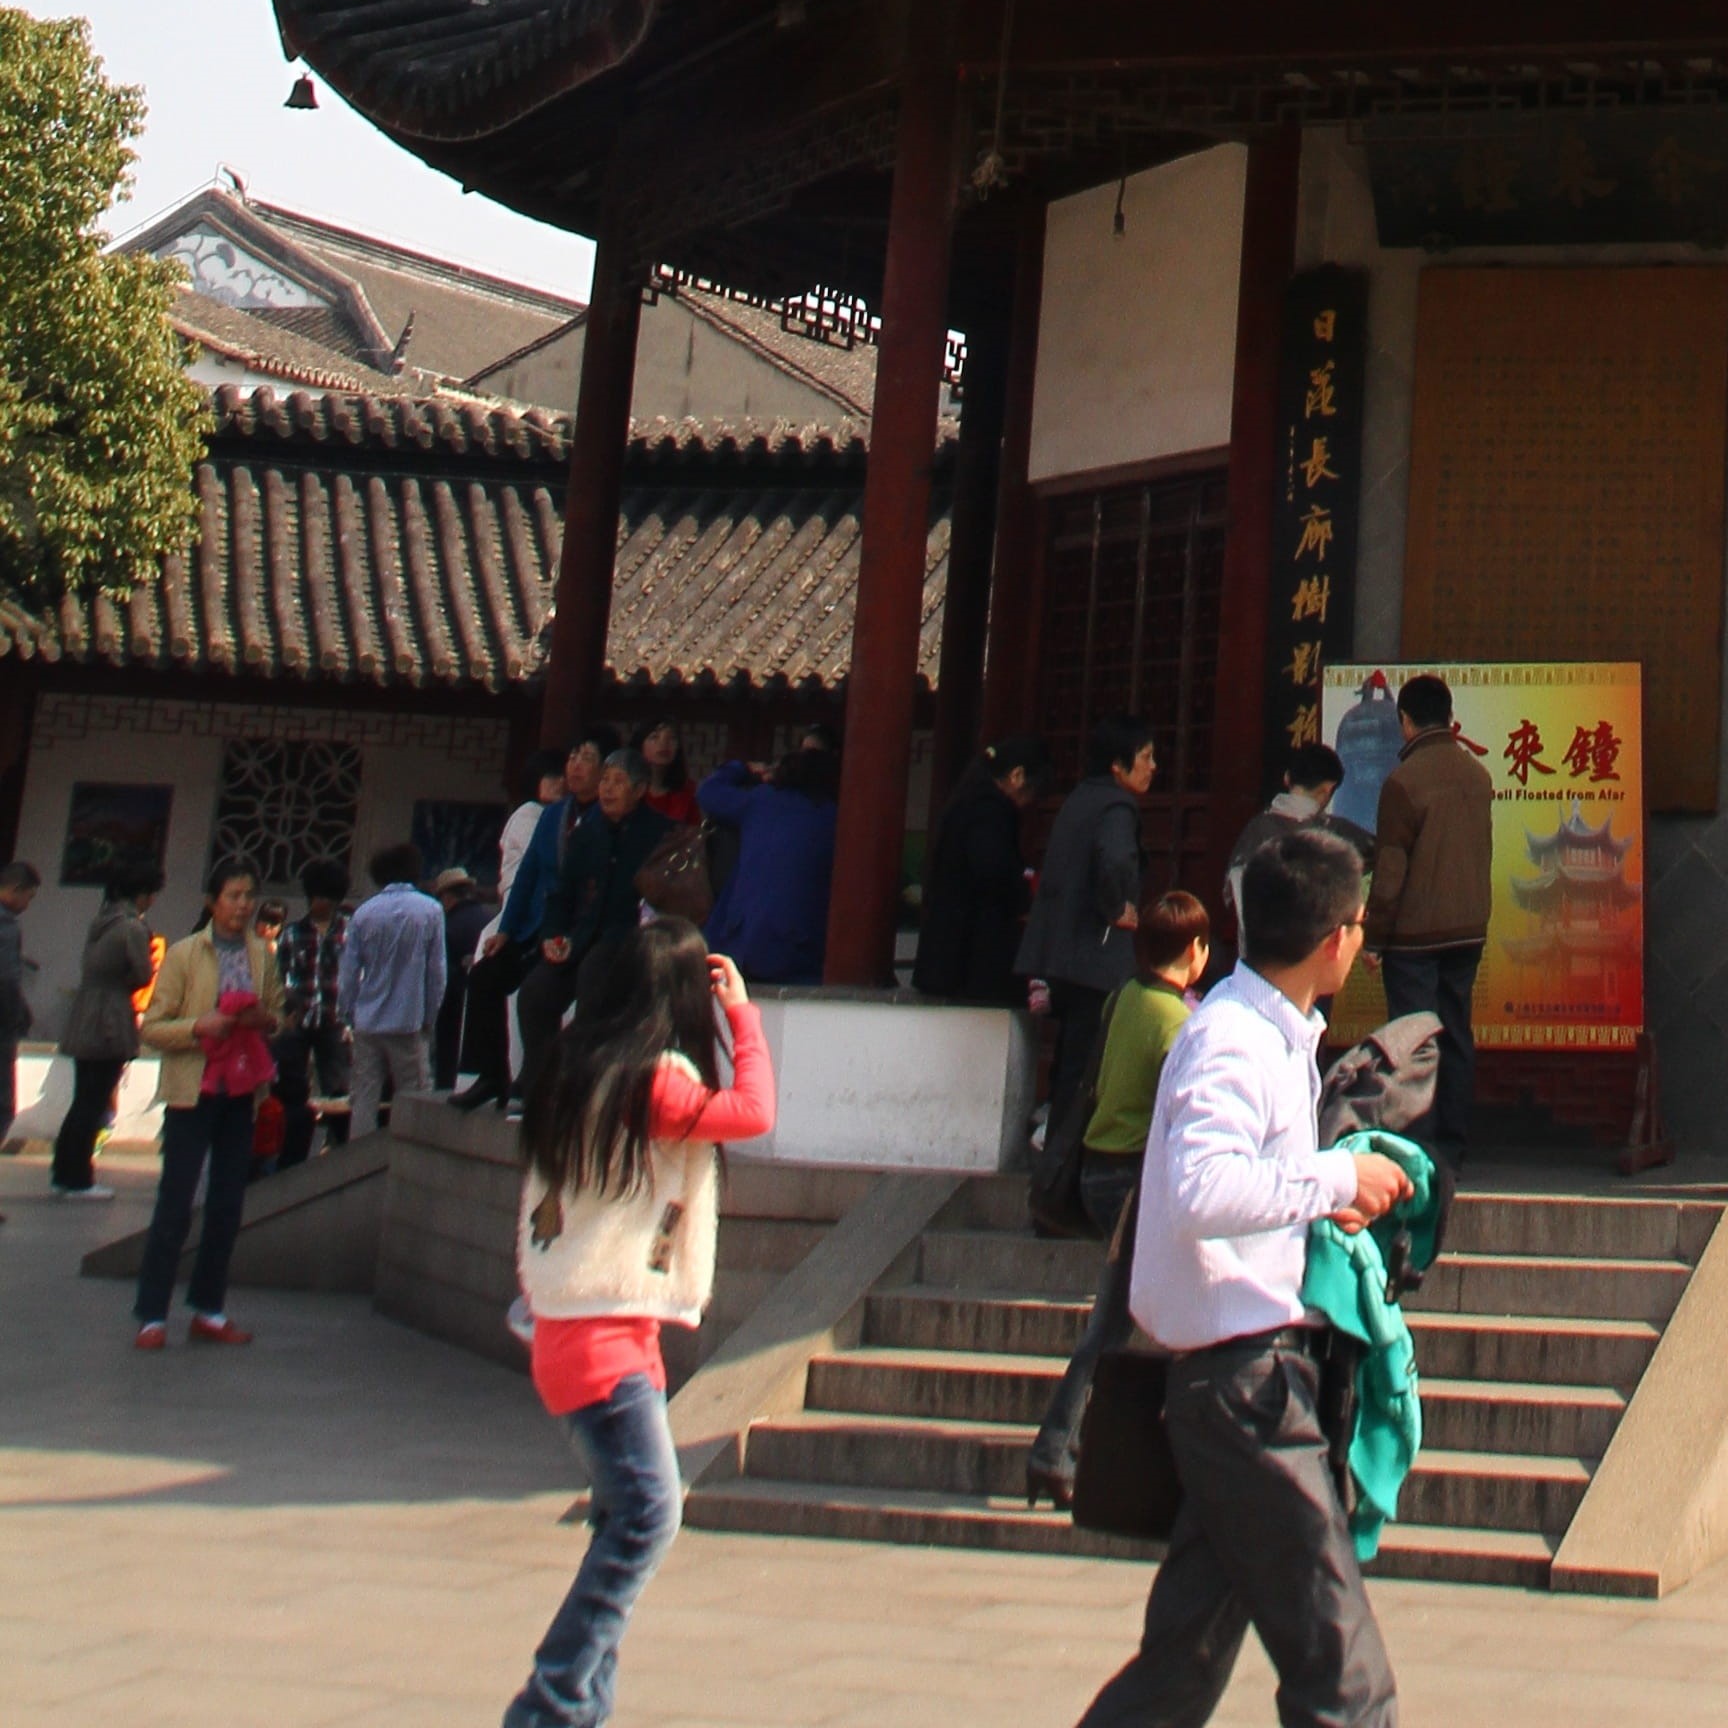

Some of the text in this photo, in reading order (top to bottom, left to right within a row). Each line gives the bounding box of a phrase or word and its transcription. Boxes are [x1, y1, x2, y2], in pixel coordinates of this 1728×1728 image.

[1516, 788, 1563, 801] Floated
[1566, 788, 1595, 801] from
[1598, 788, 1625, 801] Afar
